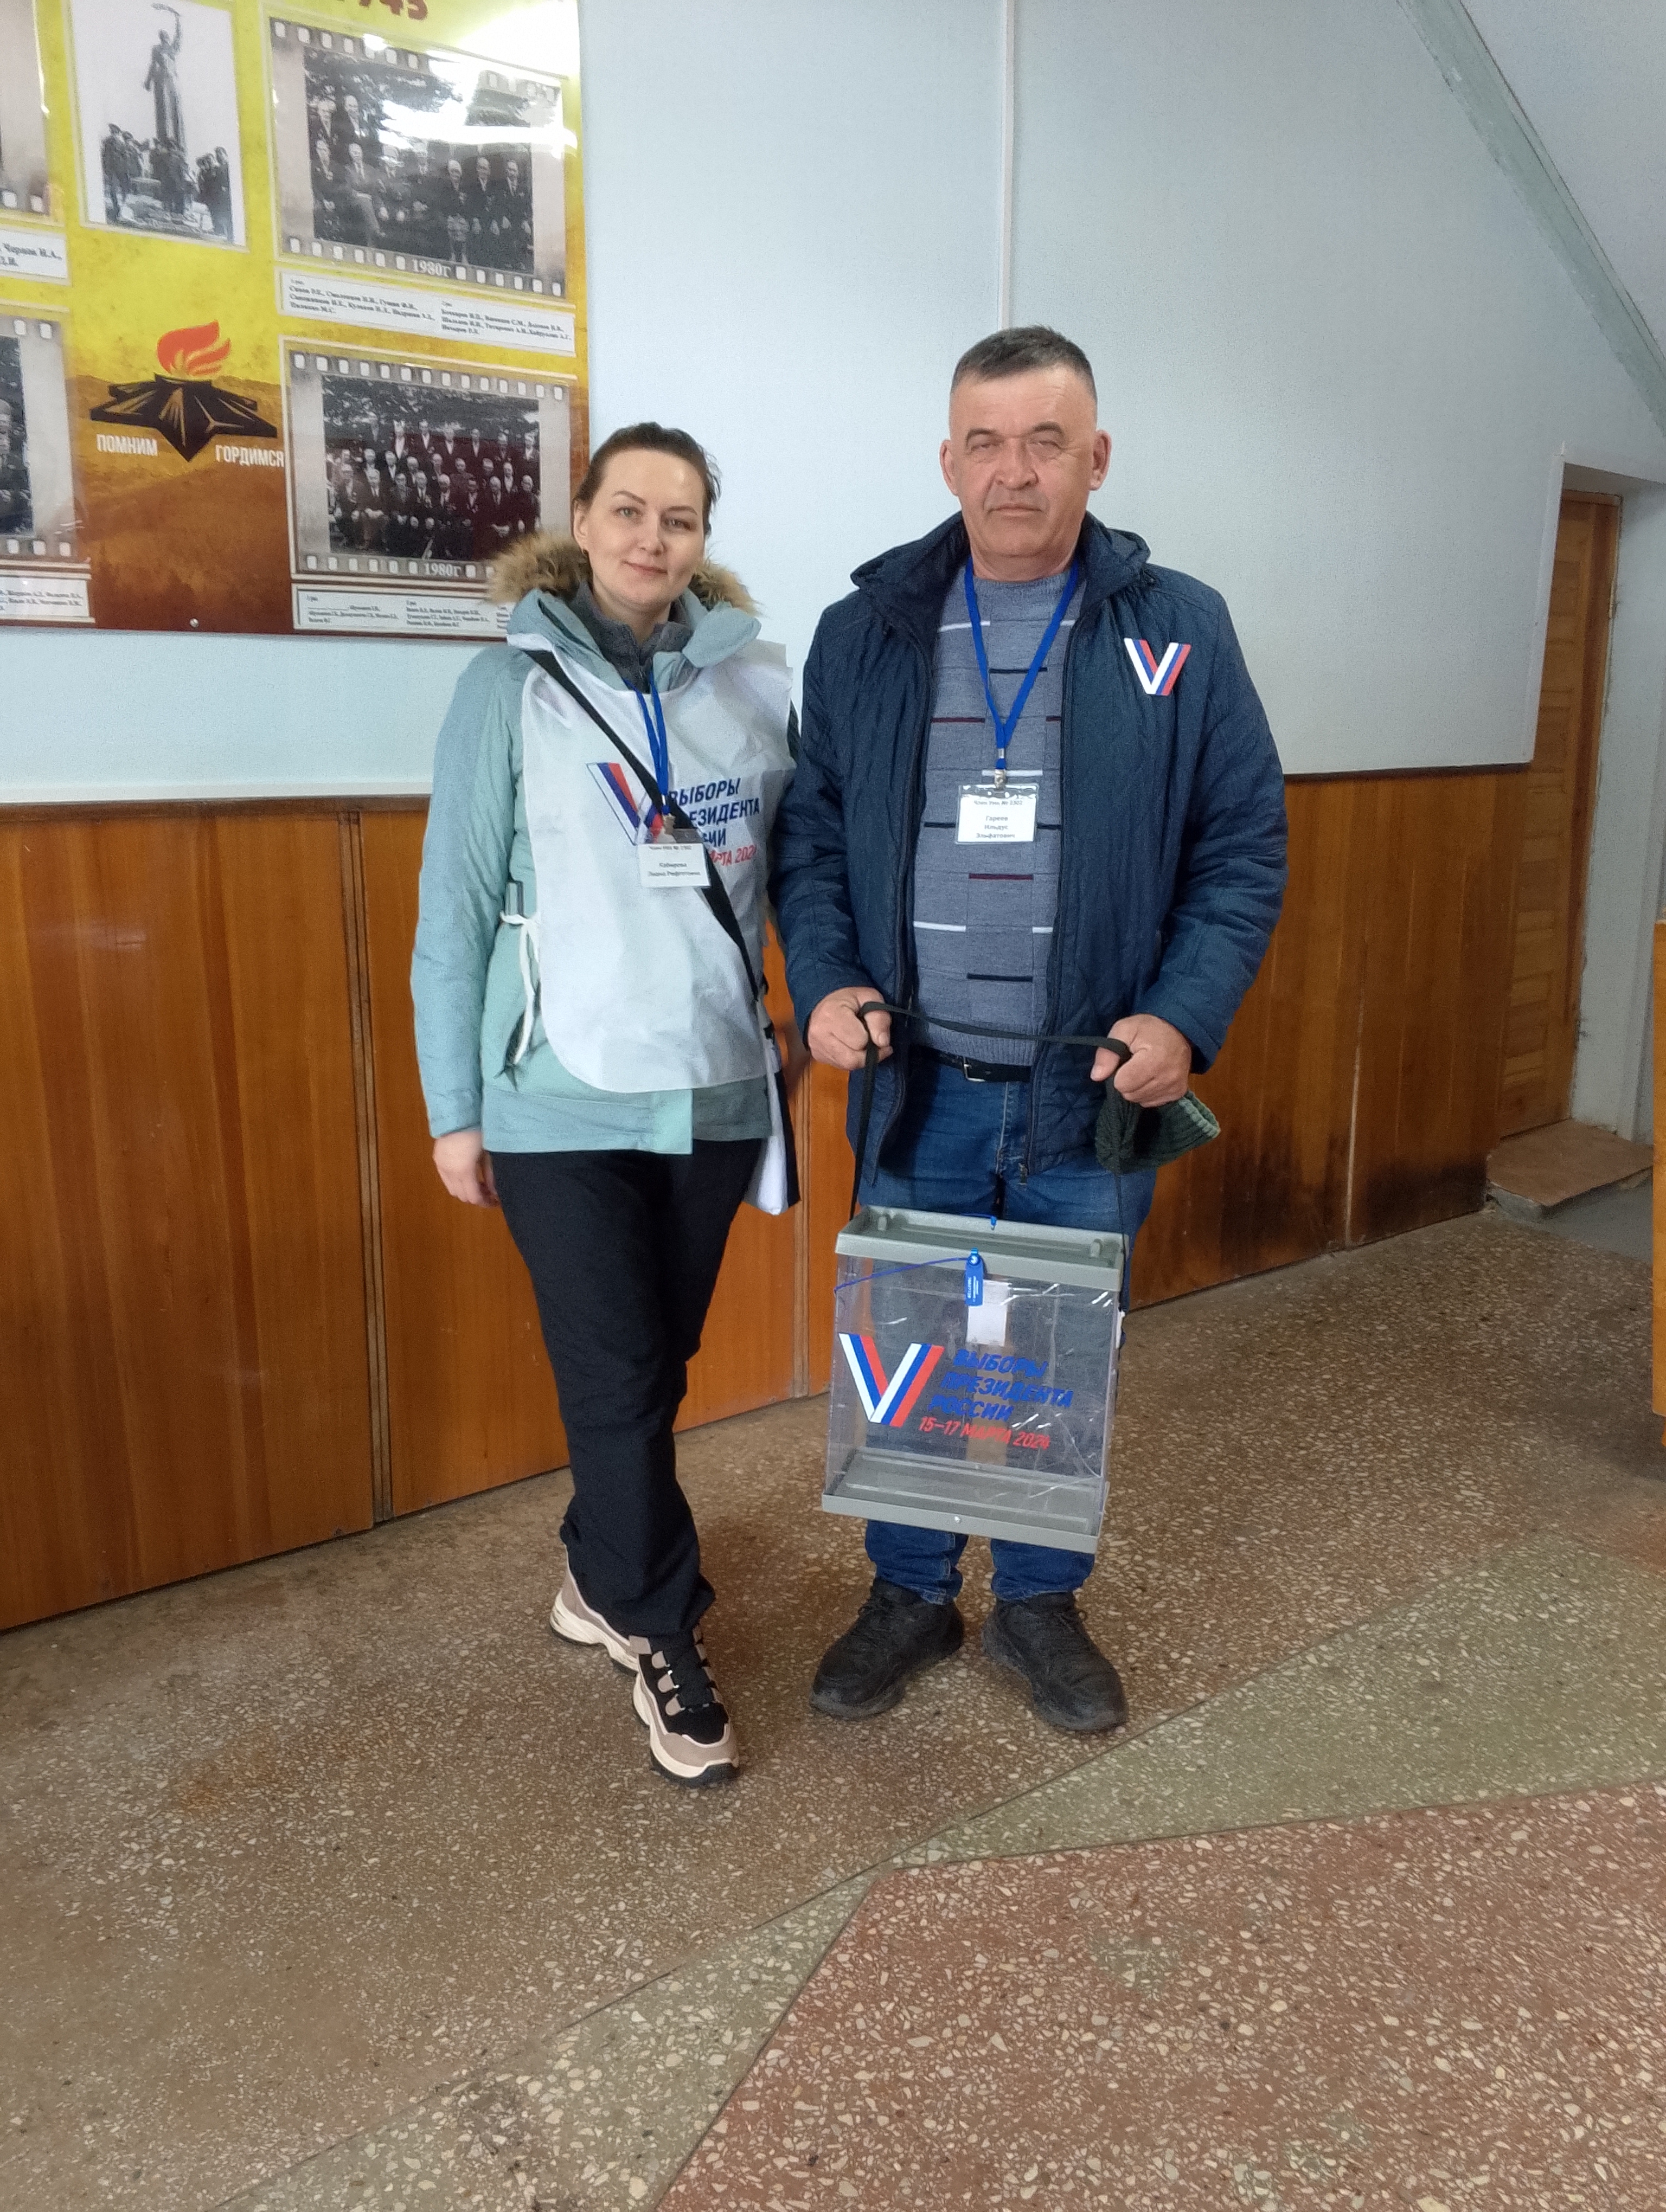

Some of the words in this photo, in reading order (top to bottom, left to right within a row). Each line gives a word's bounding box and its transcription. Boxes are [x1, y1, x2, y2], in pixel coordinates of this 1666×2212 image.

[97, 434, 158, 456] ПОМНИМ
[215, 445, 284, 467] ГОРДИМСЯ
[424, 562, 462, 578] 1980г
[689, 797, 760, 827] ЕЗИДЕНТА
[953, 1349, 1048, 1378] ВЫБОРЫ
[940, 1372, 1074, 1408] ПРЕЗИДЕНТА
[928, 1394, 1014, 1422] РОССИИ
[960, 1423, 1012, 1444] МАРТА
[1012, 1431, 1050, 1450] 2024
